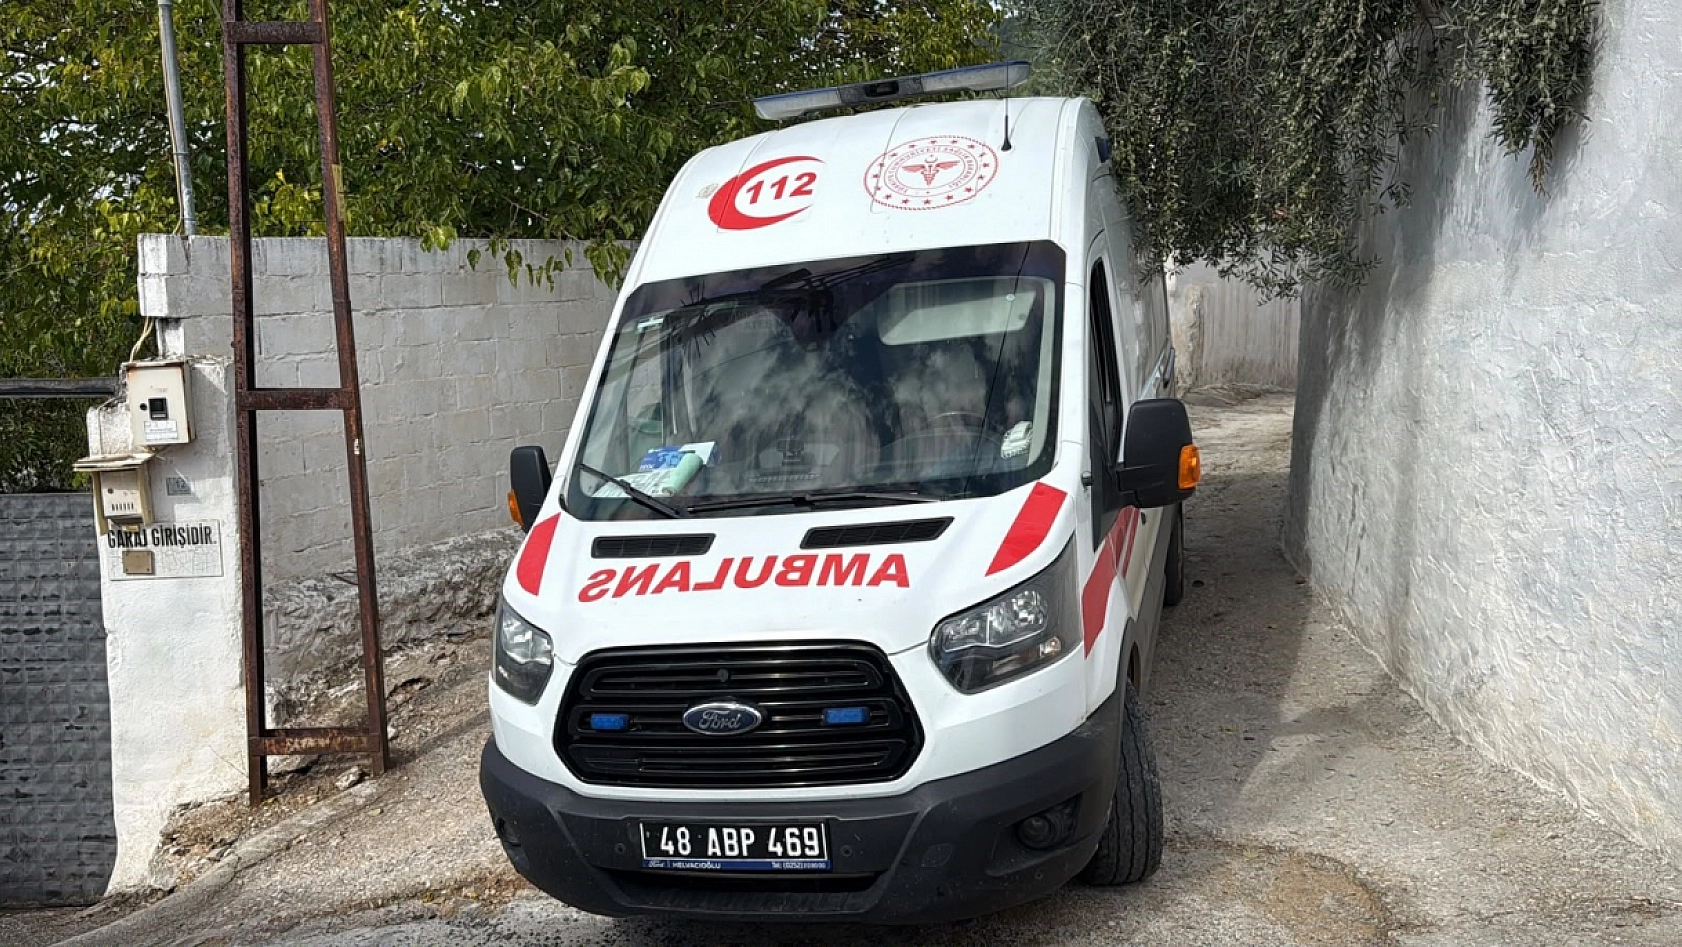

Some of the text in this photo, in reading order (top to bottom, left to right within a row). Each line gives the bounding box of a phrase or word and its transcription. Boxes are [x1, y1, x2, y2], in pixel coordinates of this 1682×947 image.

[746, 172, 817, 204] 112
[108, 529, 148, 549] GARAJ
[698, 709, 742, 731] Ford
[659, 826, 820, 857] 48 ABP 469
